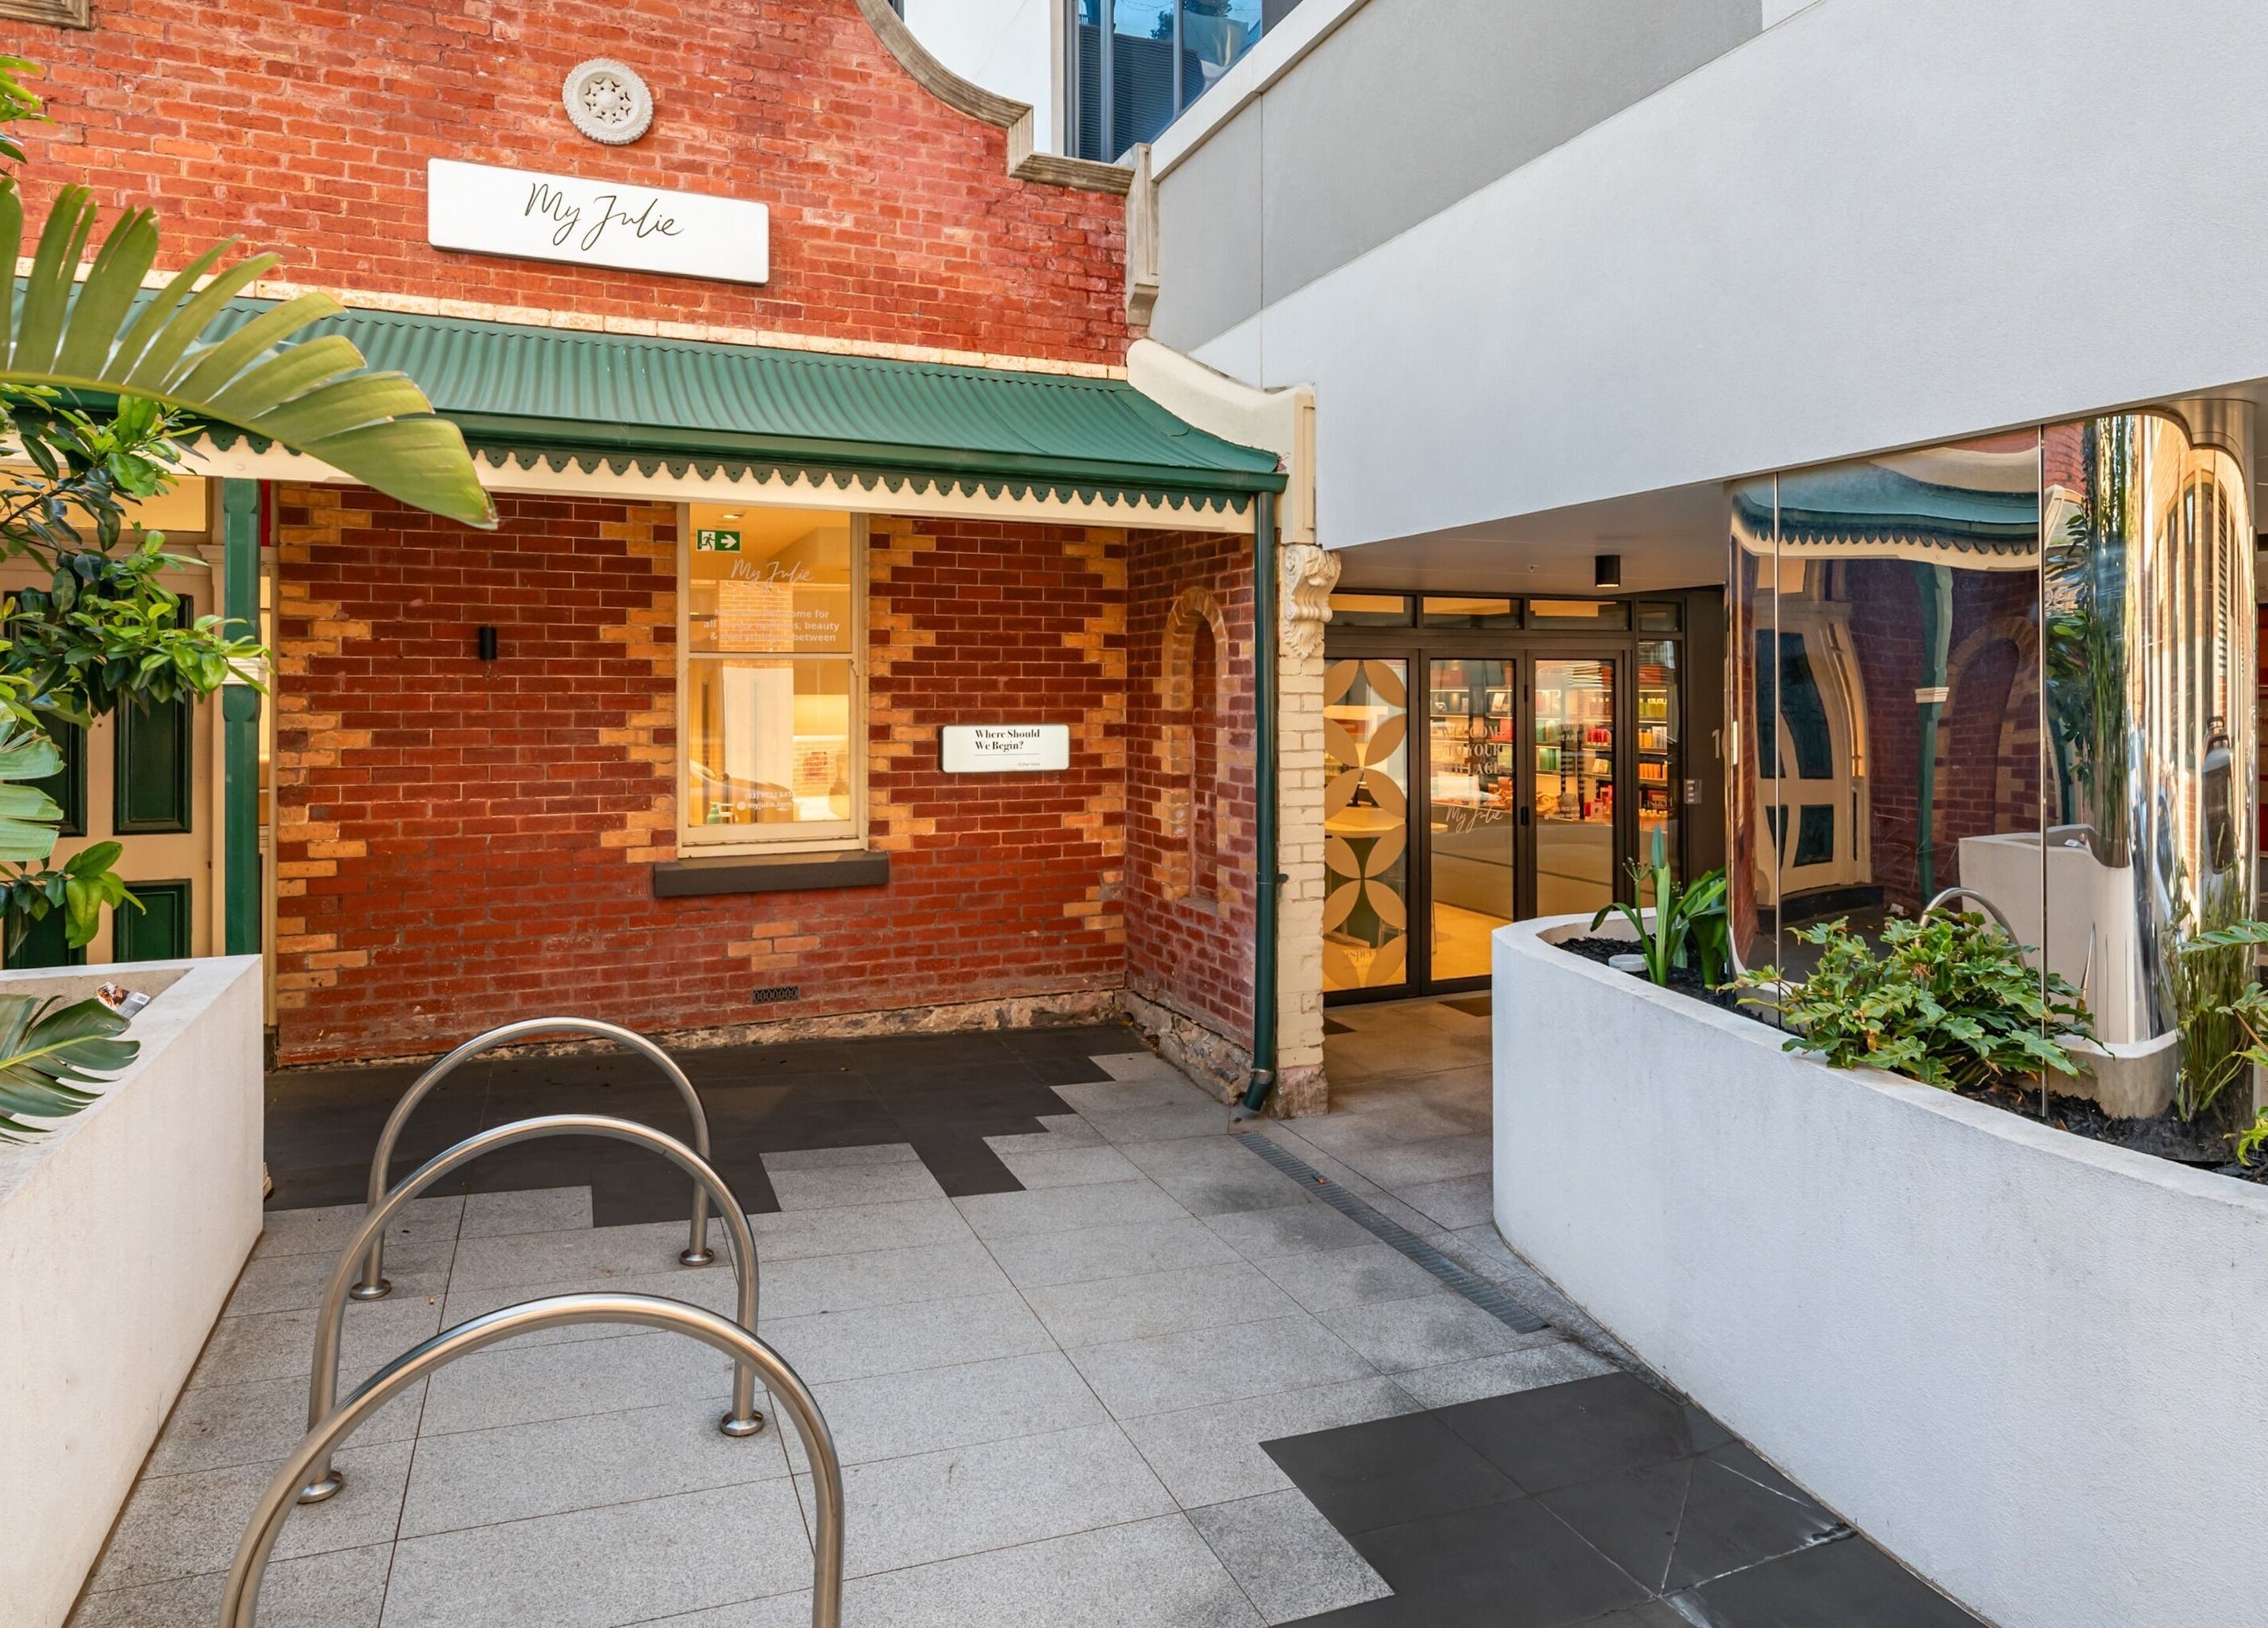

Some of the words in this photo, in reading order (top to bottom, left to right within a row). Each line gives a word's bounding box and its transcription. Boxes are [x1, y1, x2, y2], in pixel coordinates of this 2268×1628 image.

[524, 182, 581, 246] My
[581, 195, 685, 251] Julie
[730, 559, 760, 586] My
[764, 560, 815, 586] Julie
[815, 609, 828, 618] for
[804, 621, 839, 632] beauty
[794, 632, 836, 642] between
[975, 729, 1005, 738] Where
[1008, 728, 1040, 738] Should
[975, 741, 990, 750] We
[992, 740, 1024, 752] Begin?
[1446, 806, 1466, 833] My
